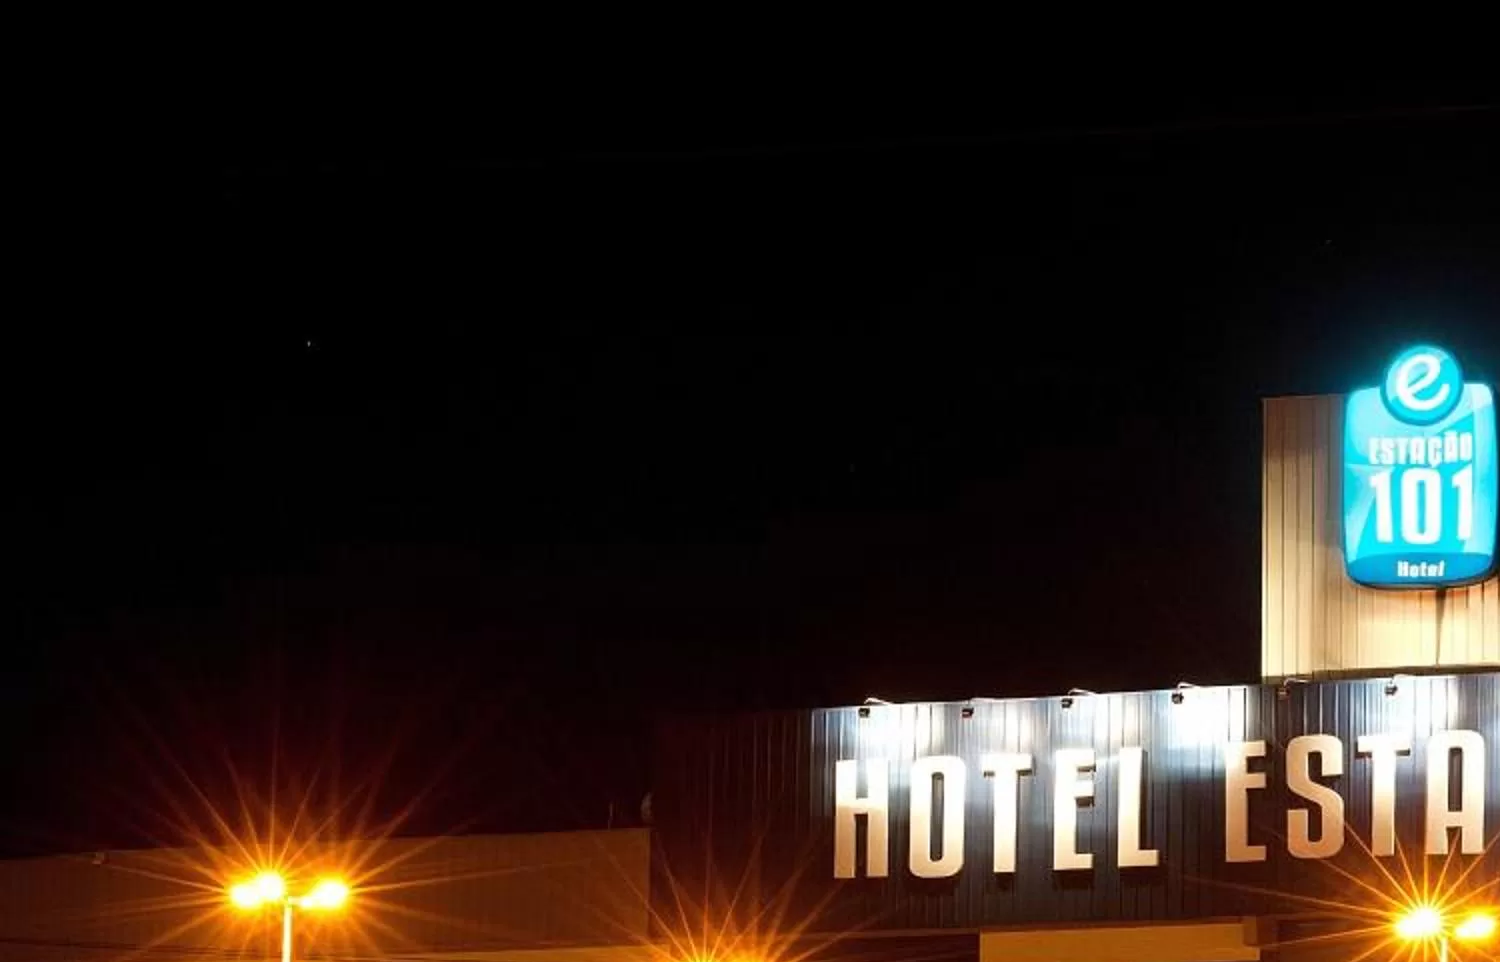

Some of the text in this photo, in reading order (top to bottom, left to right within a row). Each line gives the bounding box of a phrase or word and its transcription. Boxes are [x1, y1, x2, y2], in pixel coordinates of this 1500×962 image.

[1369, 431, 1473, 468] ESTAÇÃO
[1370, 464, 1473, 545] 101
[1397, 560, 1445, 577] Hotel
[834, 746, 1160, 879] HOTEL
